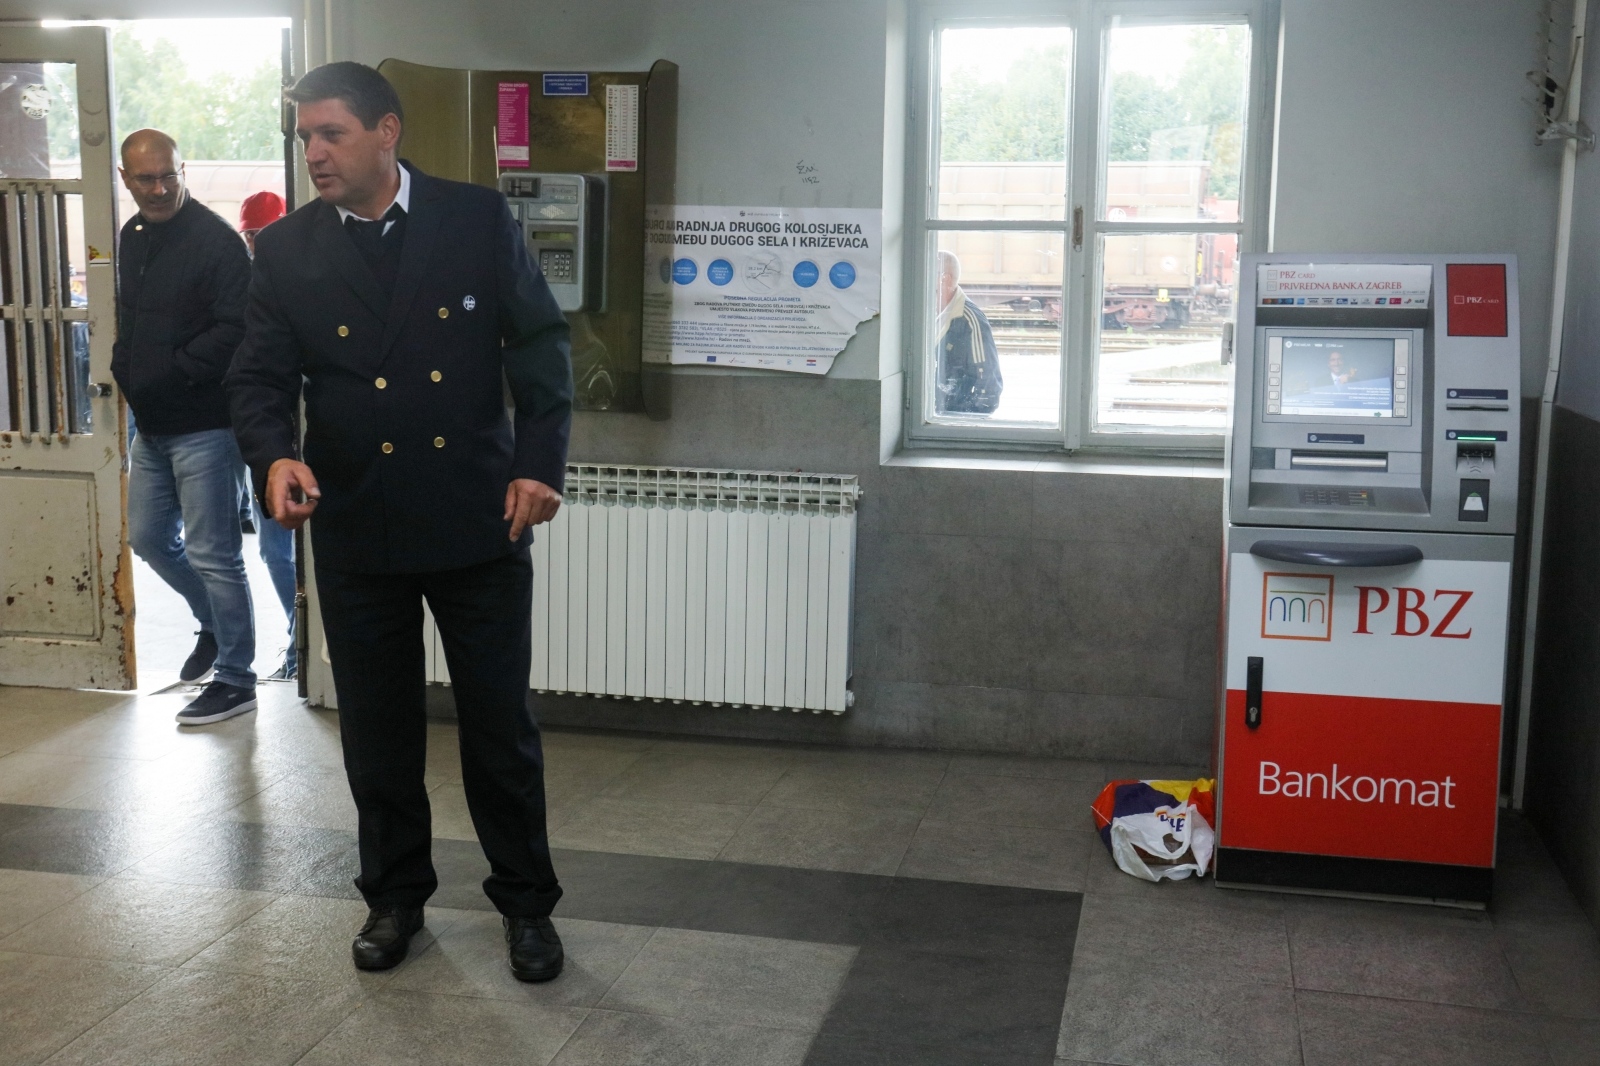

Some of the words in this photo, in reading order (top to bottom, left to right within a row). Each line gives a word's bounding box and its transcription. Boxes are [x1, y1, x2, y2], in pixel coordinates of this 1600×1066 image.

[676, 220, 726, 232] RADNJA
[729, 221, 781, 233] DRUGOG
[784, 223, 862, 235] KOLOSIJEKA
[674, 234, 707, 245] MEĐU
[710, 235, 754, 246] DUGOG
[758, 236, 789, 247] SELA
[792, 236, 796, 247] I
[800, 234, 869, 248] KRIŽEVACA
[1279, 282, 1330, 290] PRIVREDNA
[1332, 282, 1364, 290] BANKA
[1366, 282, 1402, 290] ZAGREB
[1352, 585, 1474, 640] PBZ
[1258, 760, 1456, 809] Bankomat
